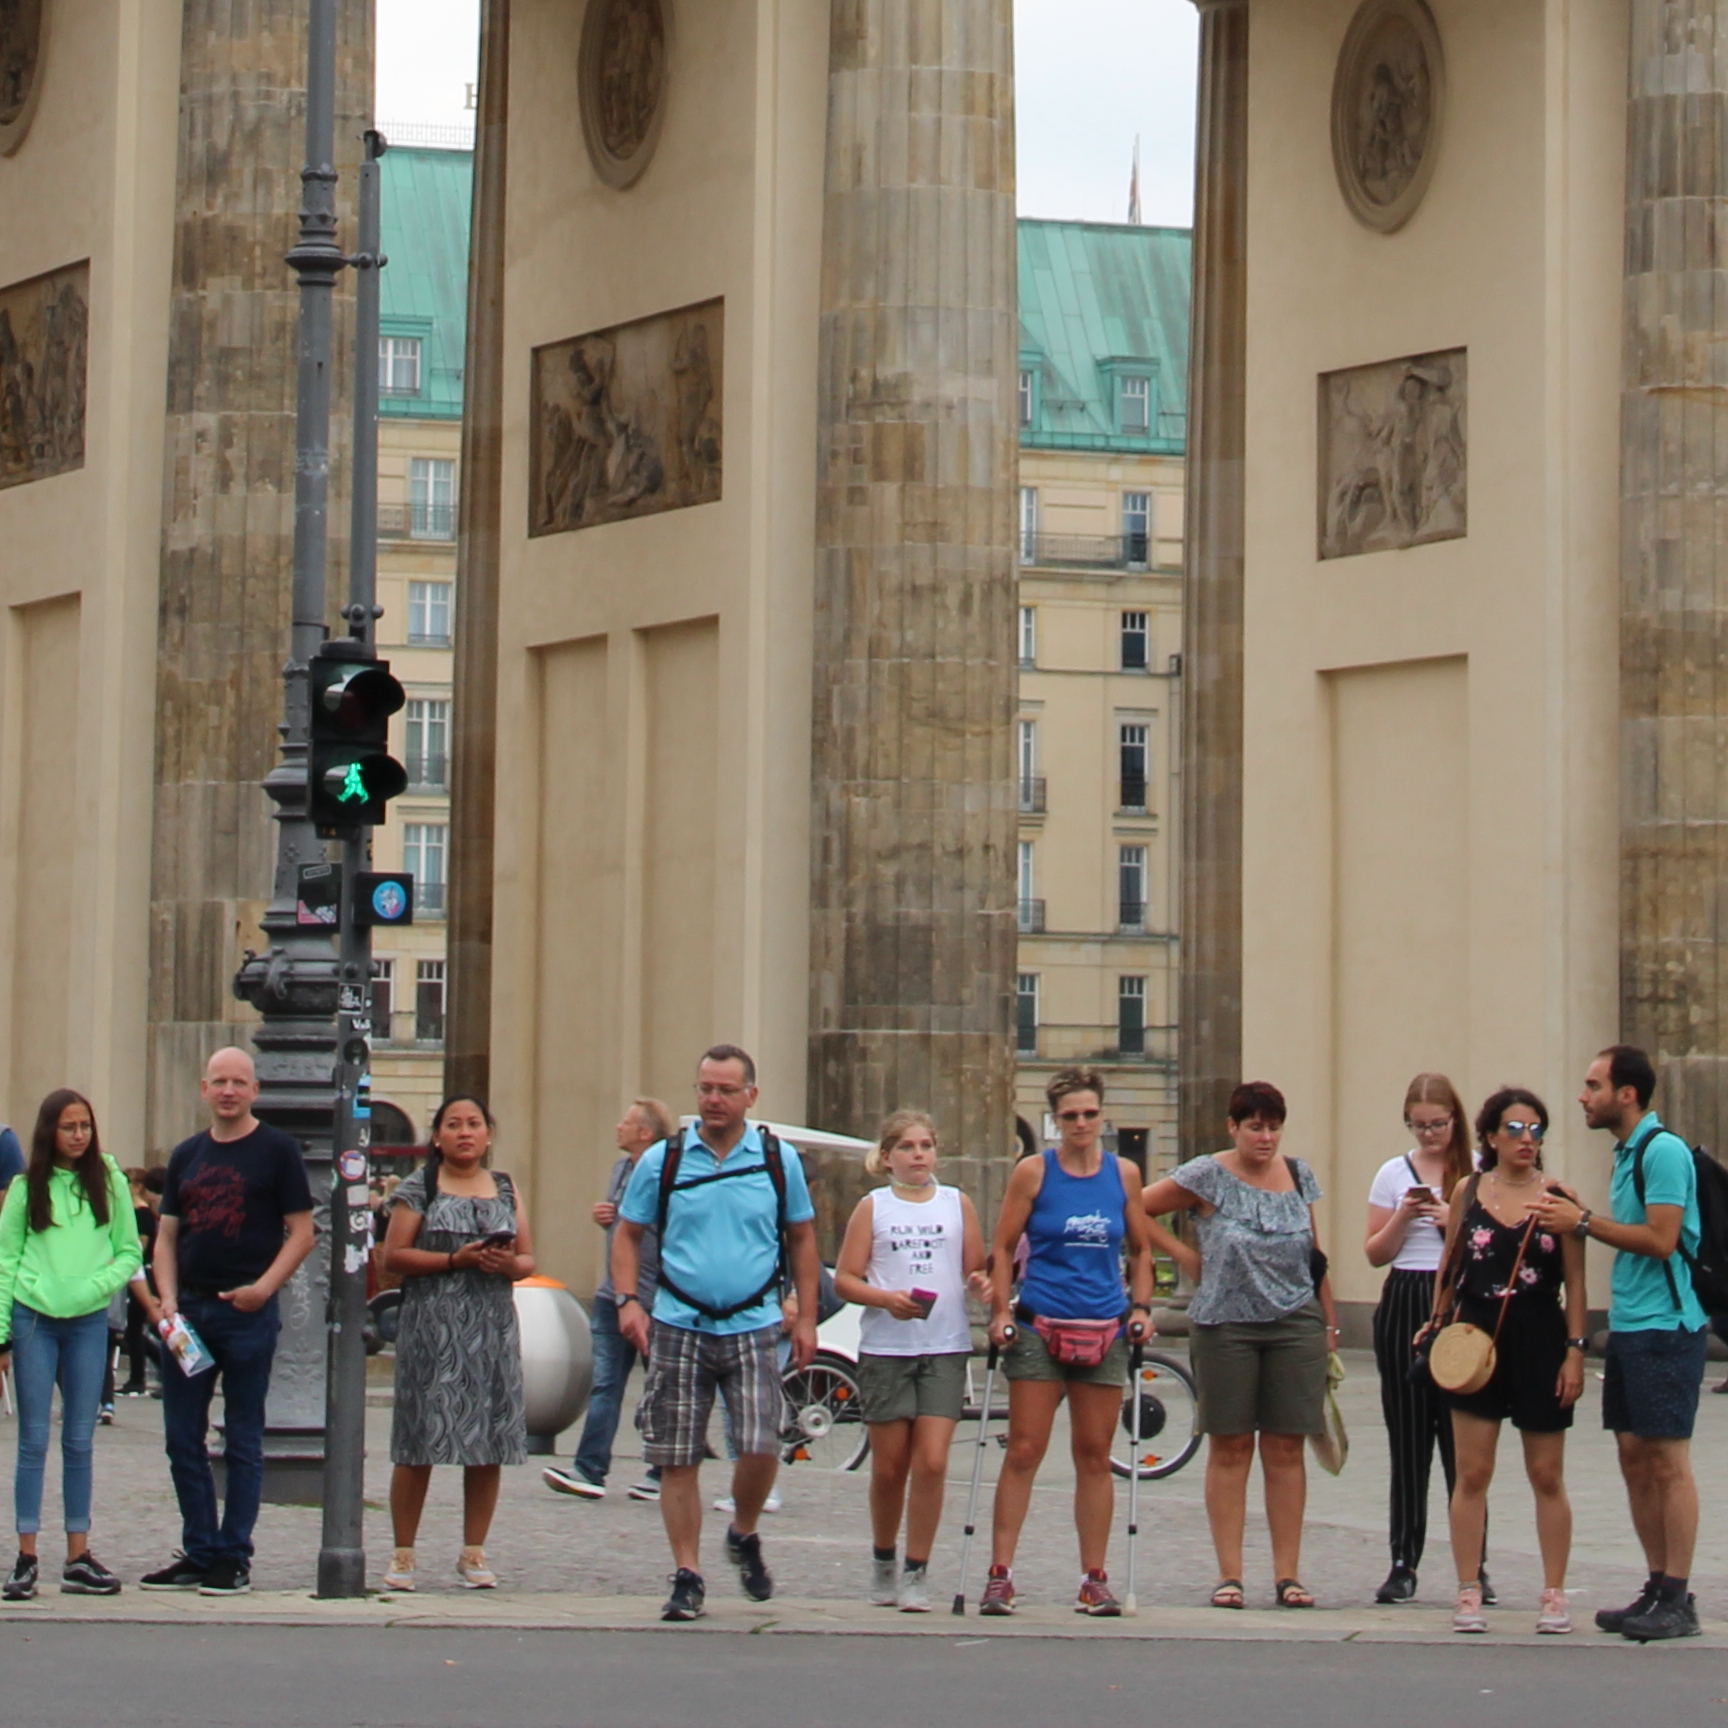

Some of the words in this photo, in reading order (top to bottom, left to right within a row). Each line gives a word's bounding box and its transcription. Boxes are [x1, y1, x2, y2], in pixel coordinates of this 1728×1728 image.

[891, 1225, 913, 1235] RUN
[917, 1224, 943, 1235] WILD
[891, 1237, 946, 1251] BAREFOOT
[912, 1250, 932, 1260] AND
[909, 1263, 934, 1275] FREE
